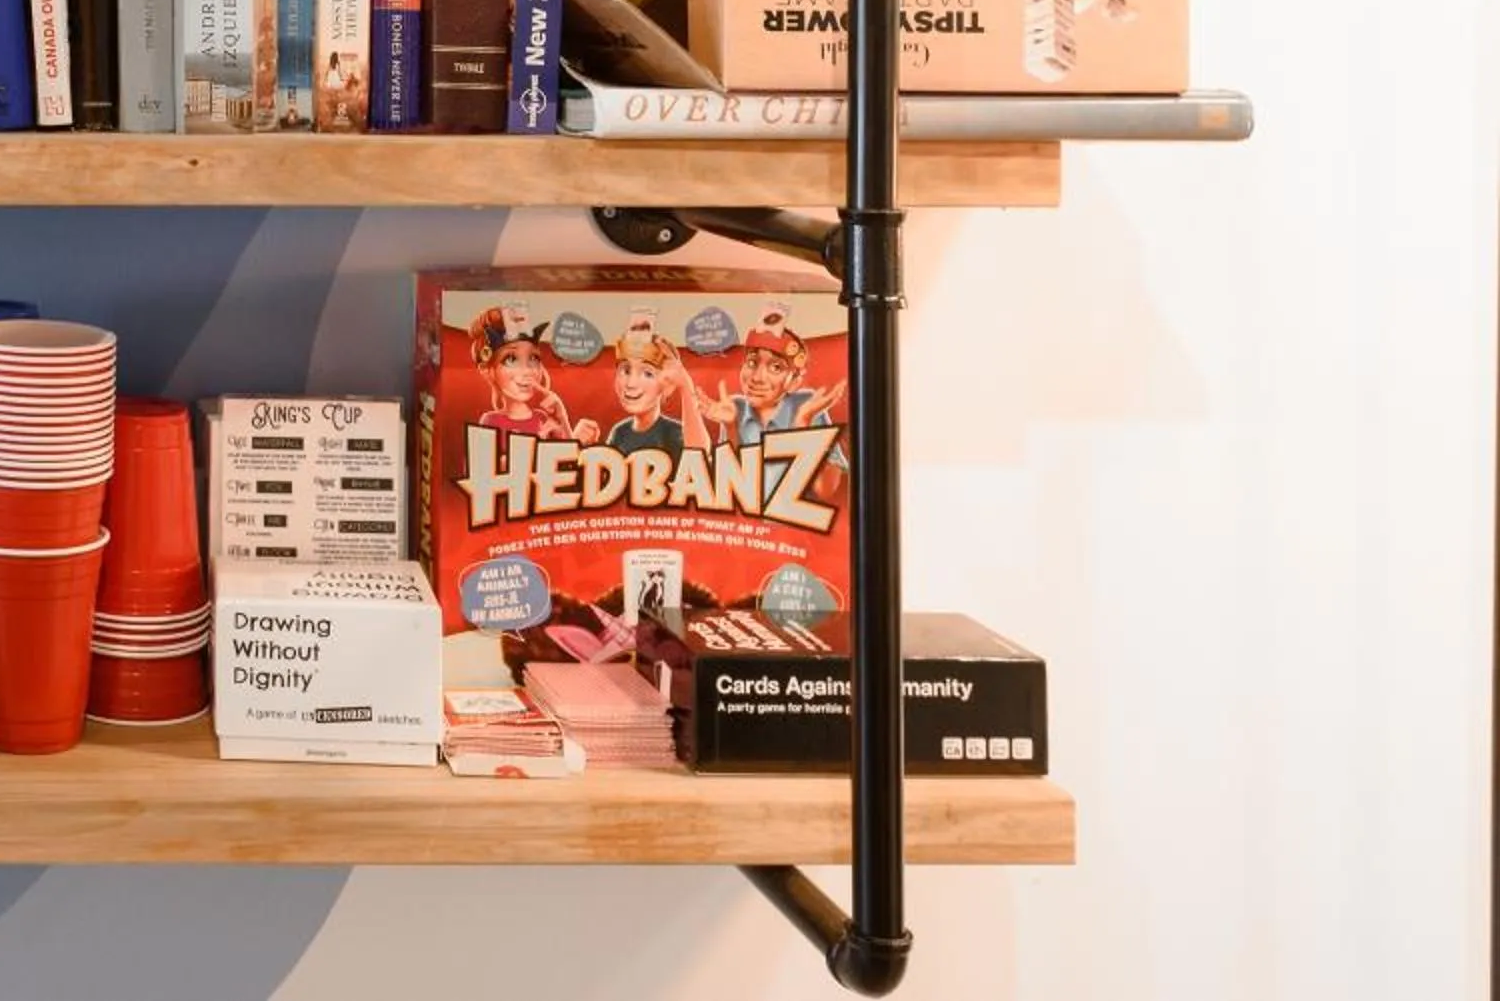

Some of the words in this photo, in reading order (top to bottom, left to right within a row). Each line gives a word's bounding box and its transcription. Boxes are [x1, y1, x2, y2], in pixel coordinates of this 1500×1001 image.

[764, 10, 848, 32] WER
[900, 11, 985, 34] TIPSY
[390, 14, 403, 55] BONES
[525, 7, 547, 67] New
[43, 19, 59, 79] CANADA
[390, 59, 402, 100] NEVER
[624, 94, 741, 123] OVER
[251, 402, 312, 430] KING'S
[321, 403, 363, 431] CUP
[456, 423, 847, 535] HEDBANZ
[553, 518, 587, 532] QUICK
[589, 516, 645, 528] QUESTION
[647, 516, 679, 527] GAME
[579, 530, 641, 542] QUESTIONS
[234, 611, 332, 637] Drawing
[233, 638, 321, 662] Without
[232, 666, 314, 692] Dignity
[715, 674, 781, 695] Cards
[785, 675, 851, 700] Agains
[900, 677, 974, 701] manity
[717, 700, 726, 712] A
[727, 703, 756, 714] party
[757, 704, 786, 714] game
[788, 702, 803, 712] for
[804, 702, 844, 713] horrible
